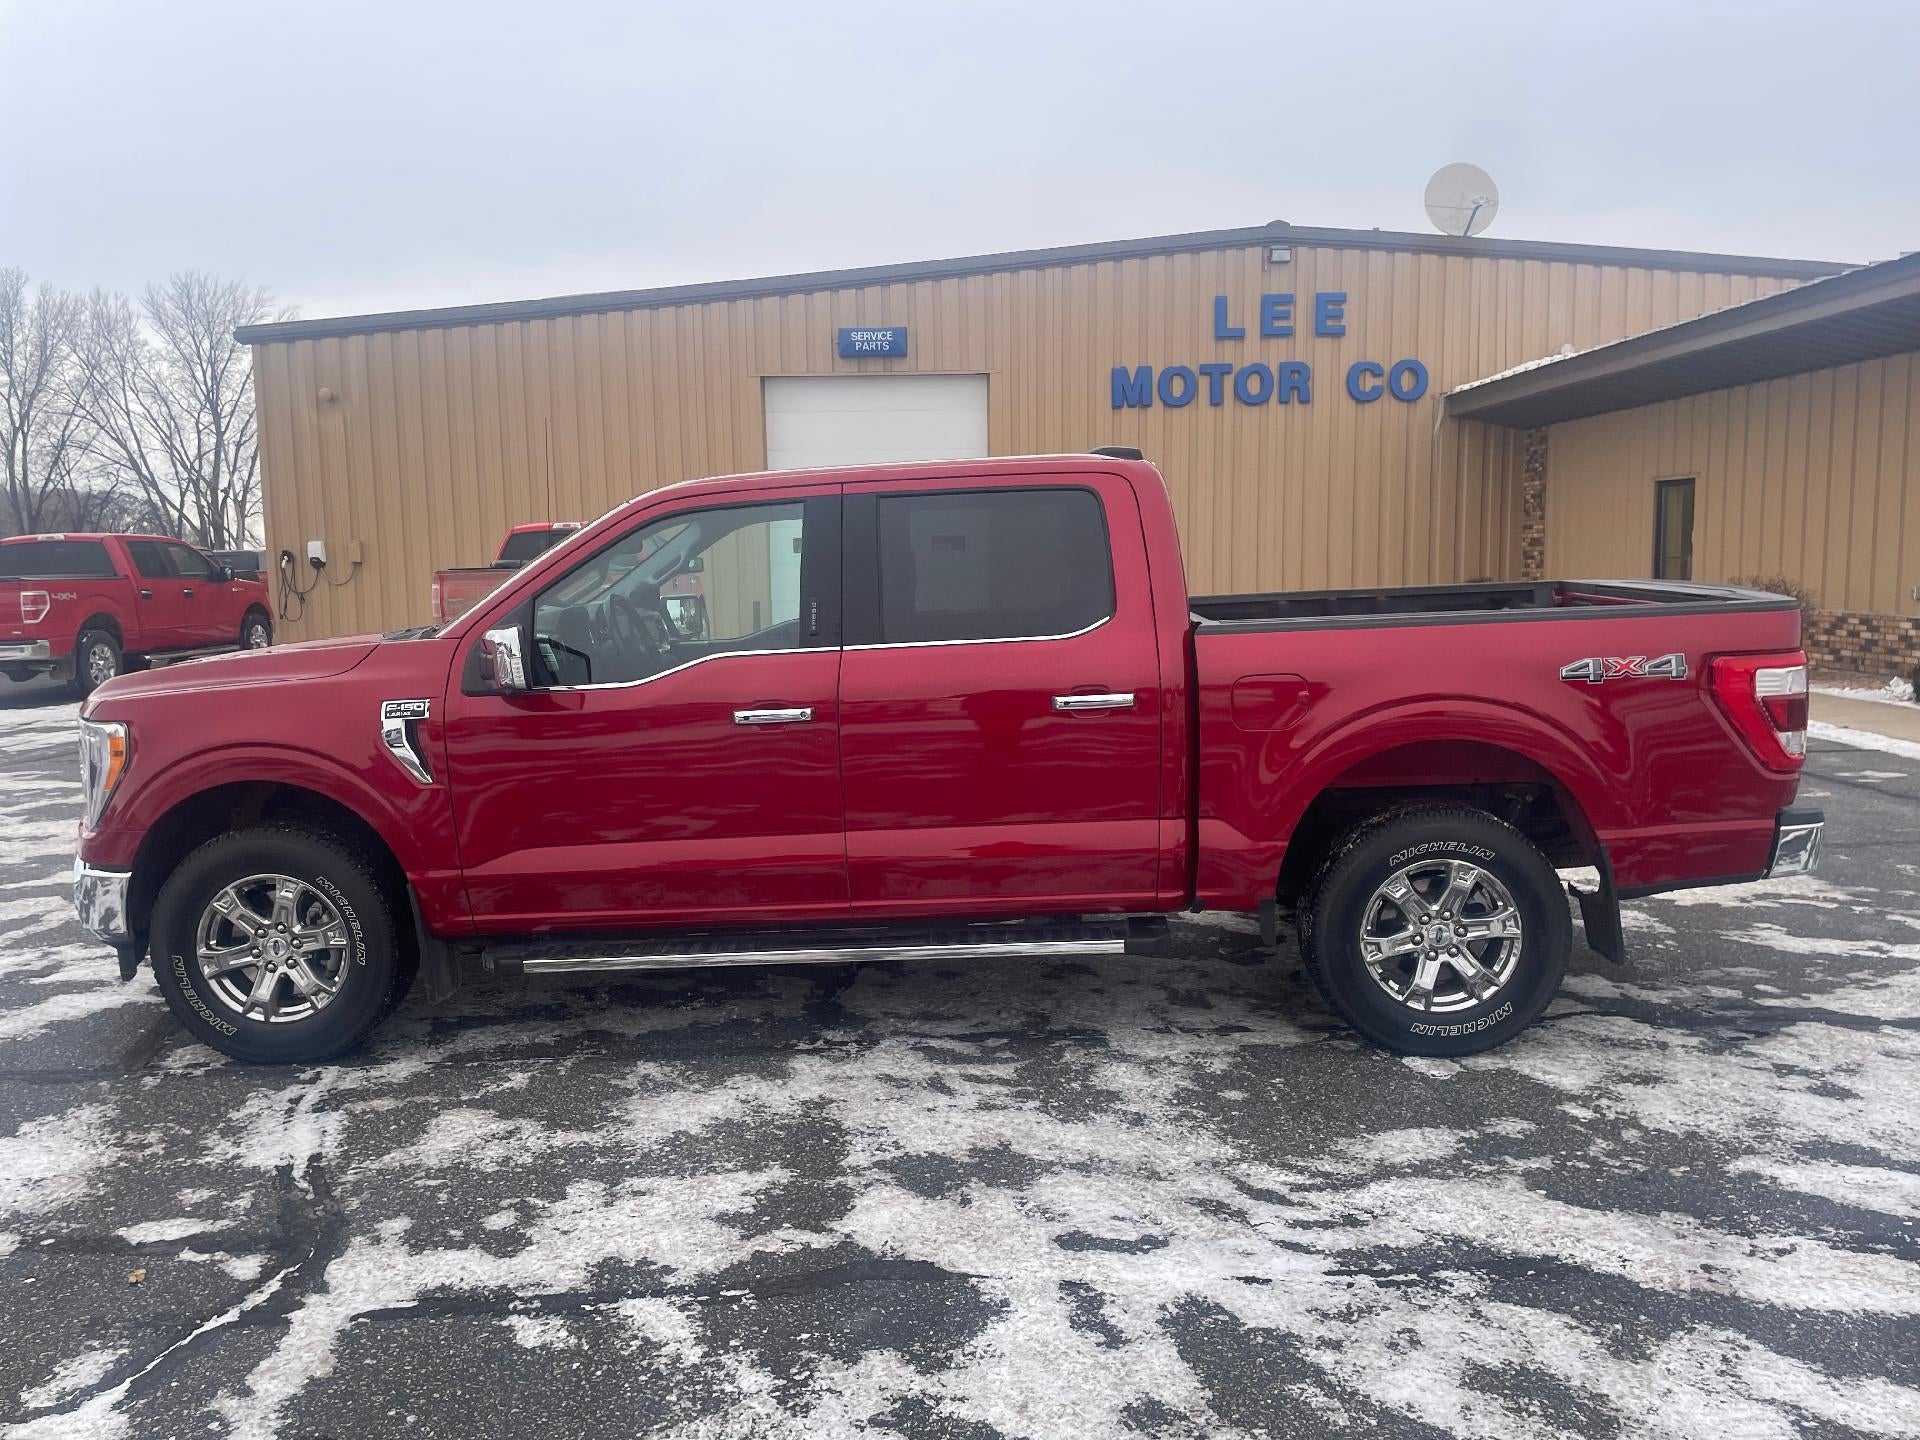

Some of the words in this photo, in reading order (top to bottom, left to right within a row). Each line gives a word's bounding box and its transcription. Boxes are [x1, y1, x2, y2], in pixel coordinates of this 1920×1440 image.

[1214, 291, 1347, 341] LEE
[850, 331, 894, 341] SERVICE
[855, 341, 890, 351] PARTS
[1111, 361, 1311, 410] MOTOR
[1346, 358, 1429, 404] CO
[386, 703, 425, 711] F-150
[1389, 841, 1496, 867] MICHELIN
[315, 876, 366, 966] MICHELIN
[171, 954, 239, 1036] MICHELIN
[1410, 1001, 1513, 1037] MICHELIN
